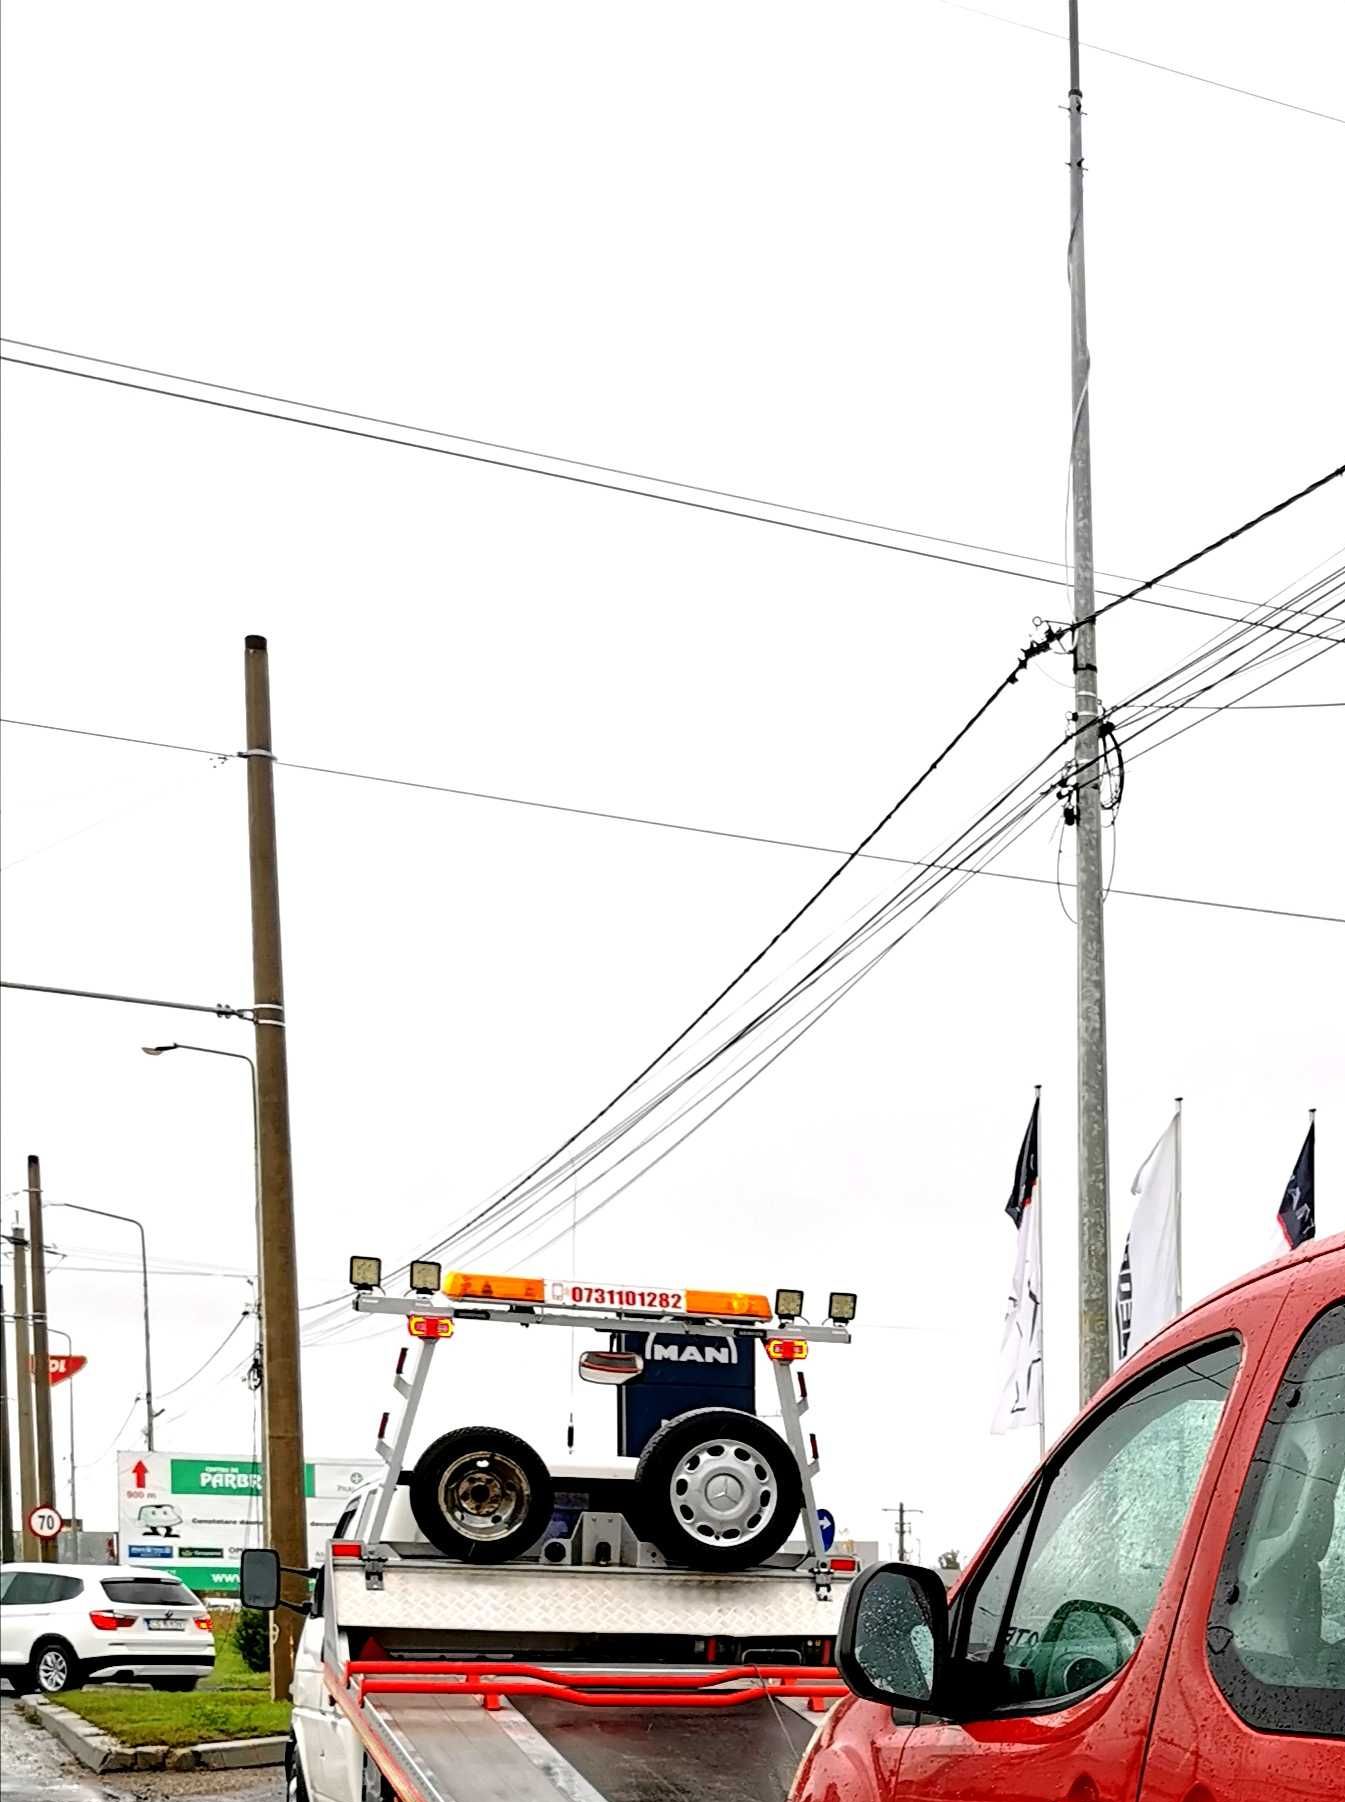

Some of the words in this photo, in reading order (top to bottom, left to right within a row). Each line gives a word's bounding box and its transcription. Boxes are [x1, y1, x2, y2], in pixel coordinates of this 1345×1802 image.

[571, 1286, 682, 1309] 0731101282
[653, 1344, 729, 1364] MAN
[200, 1472, 262, 1490] PARBR
[37, 1515, 55, 1530] 70
